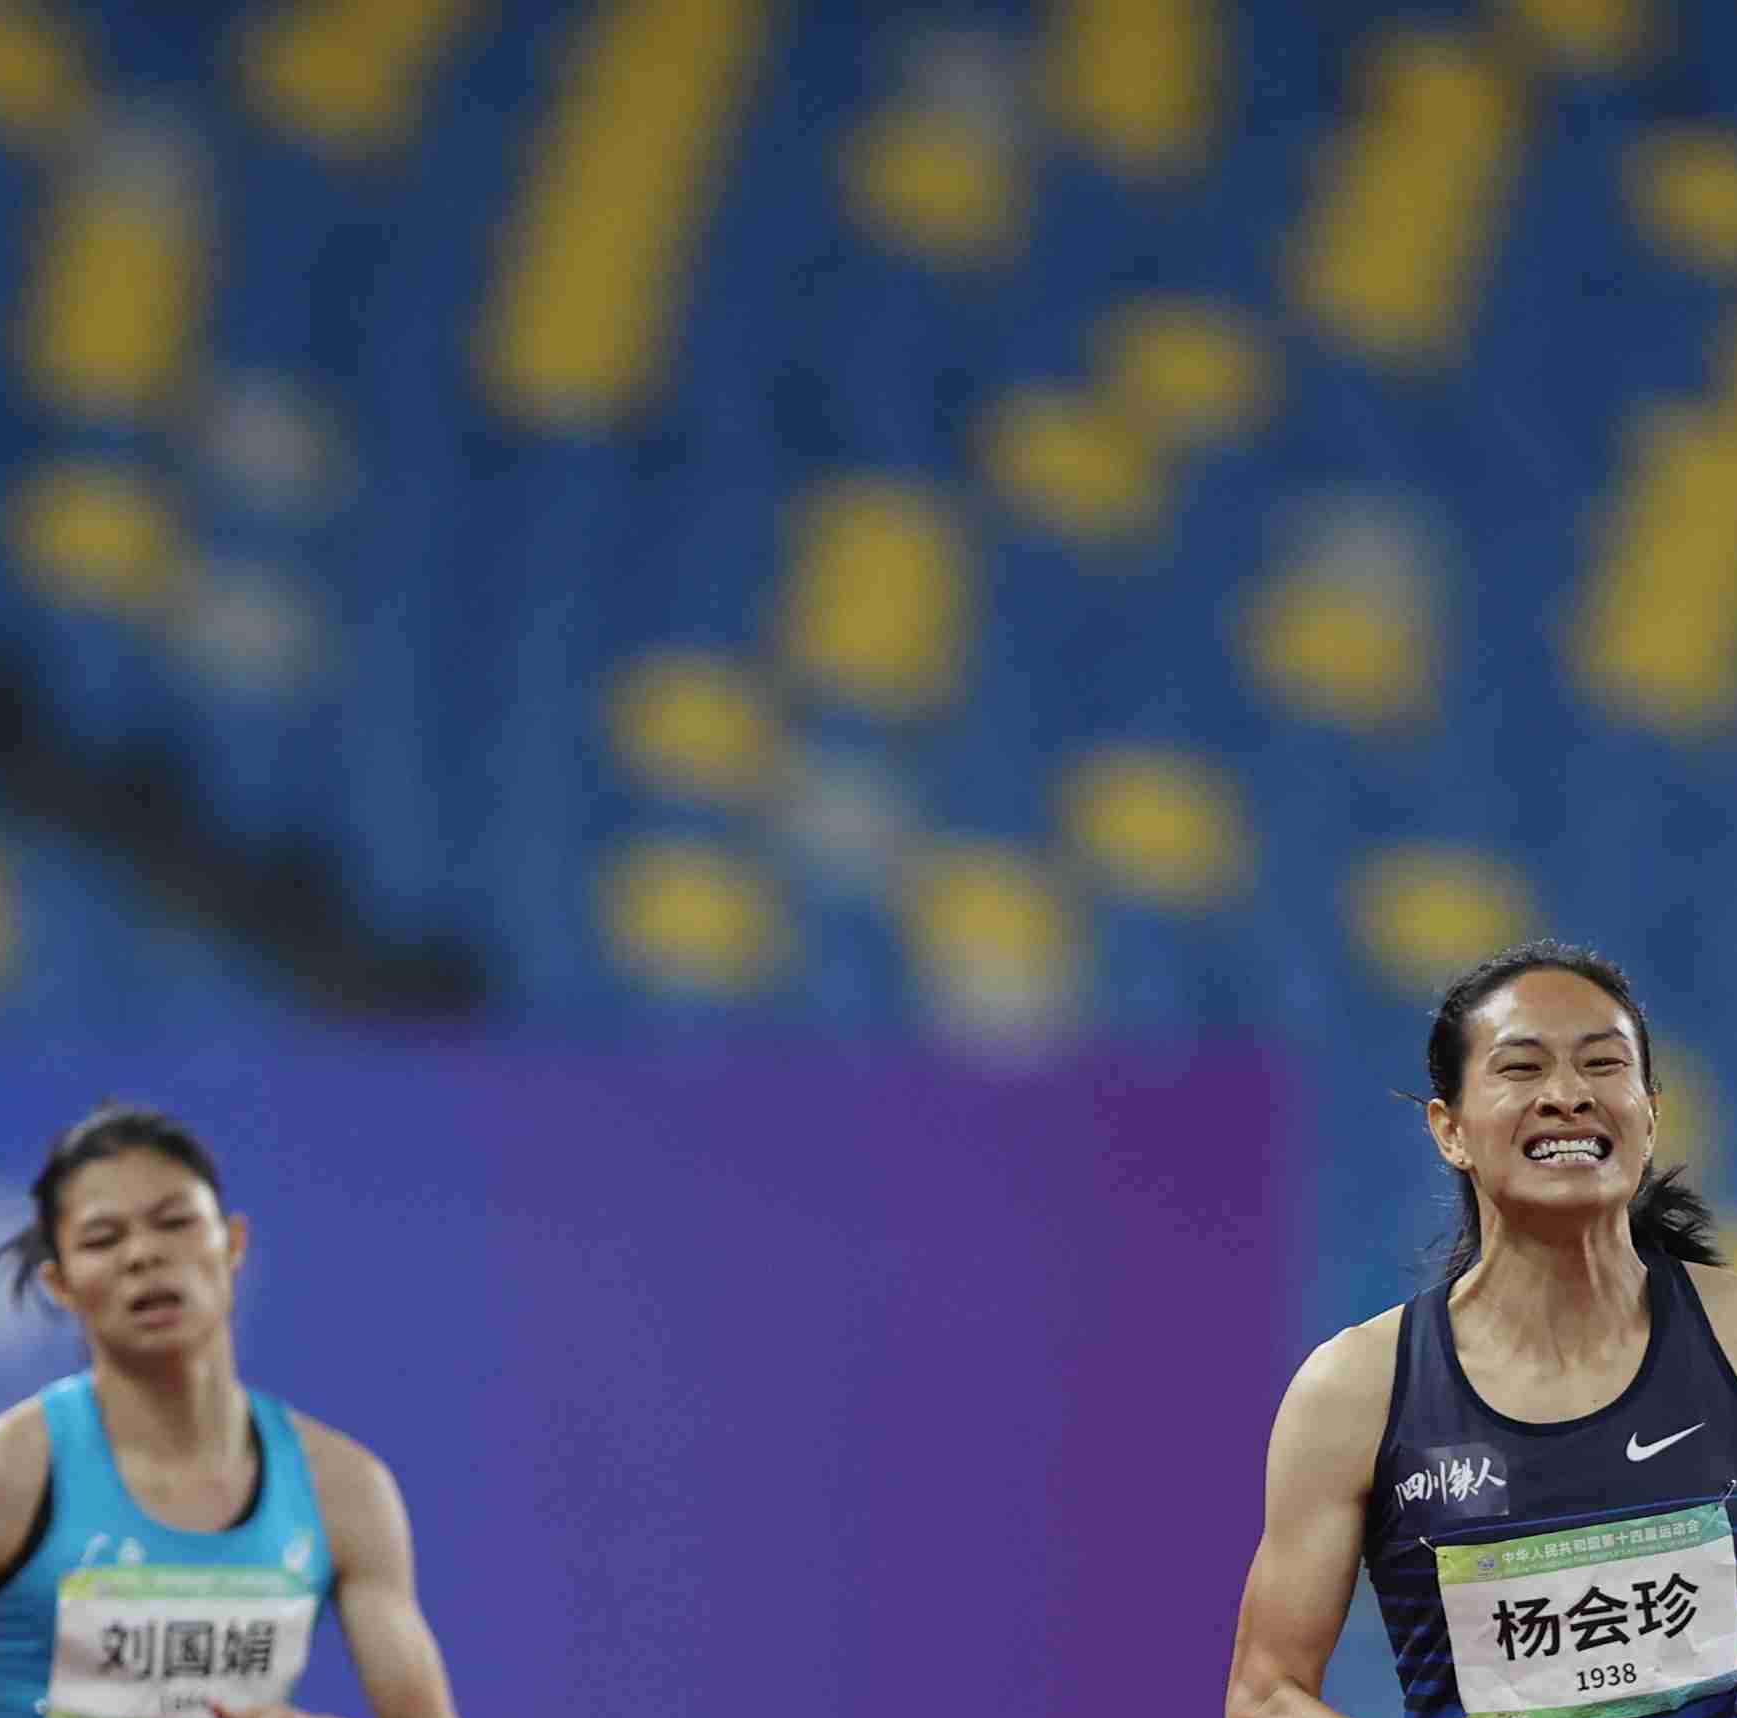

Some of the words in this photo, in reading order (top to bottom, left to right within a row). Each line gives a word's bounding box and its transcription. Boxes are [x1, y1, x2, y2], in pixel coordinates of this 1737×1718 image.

[1493, 1572, 1699, 1661] 杨会珍
[99, 1617, 277, 1682] 刘国娟
[1576, 1662, 1638, 1692] 1938
